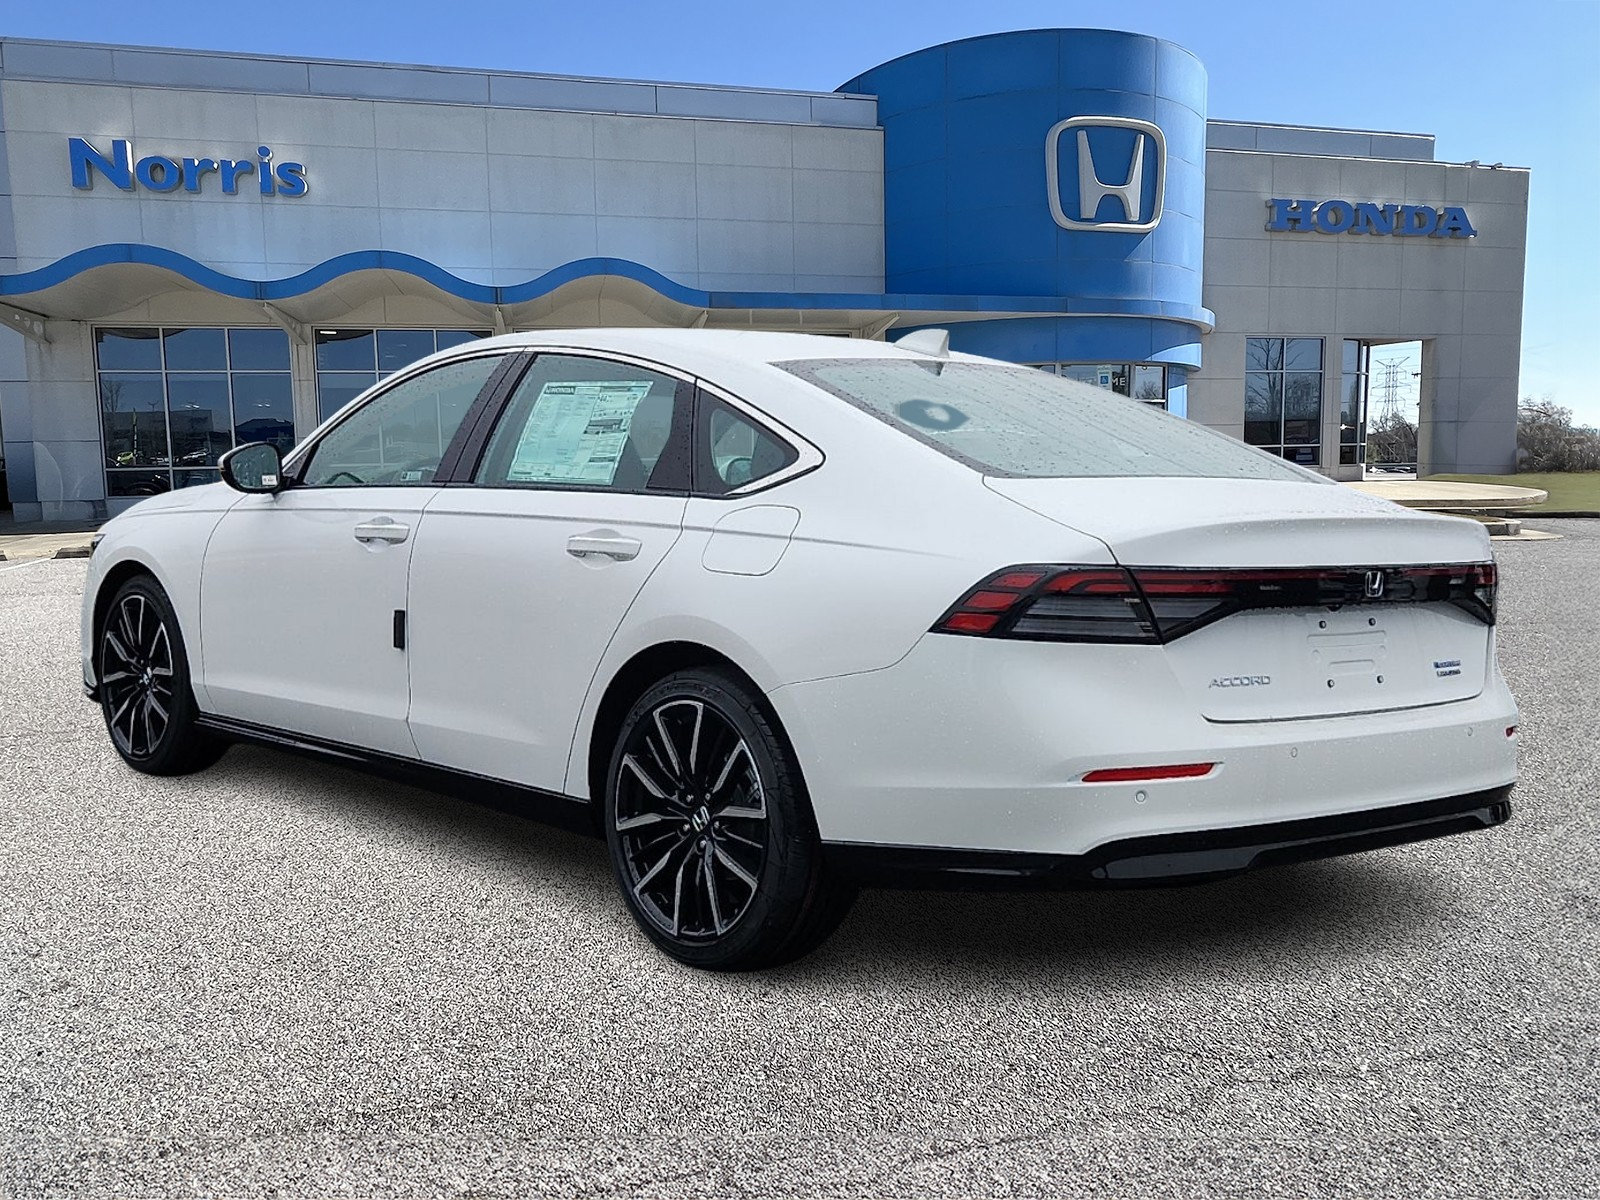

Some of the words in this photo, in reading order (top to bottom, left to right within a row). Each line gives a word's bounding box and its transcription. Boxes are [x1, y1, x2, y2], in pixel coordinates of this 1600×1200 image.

[68, 137, 309, 198] Norris
[1265, 198, 1478, 240] HONDA
[1208, 675, 1271, 689] ACCORD
